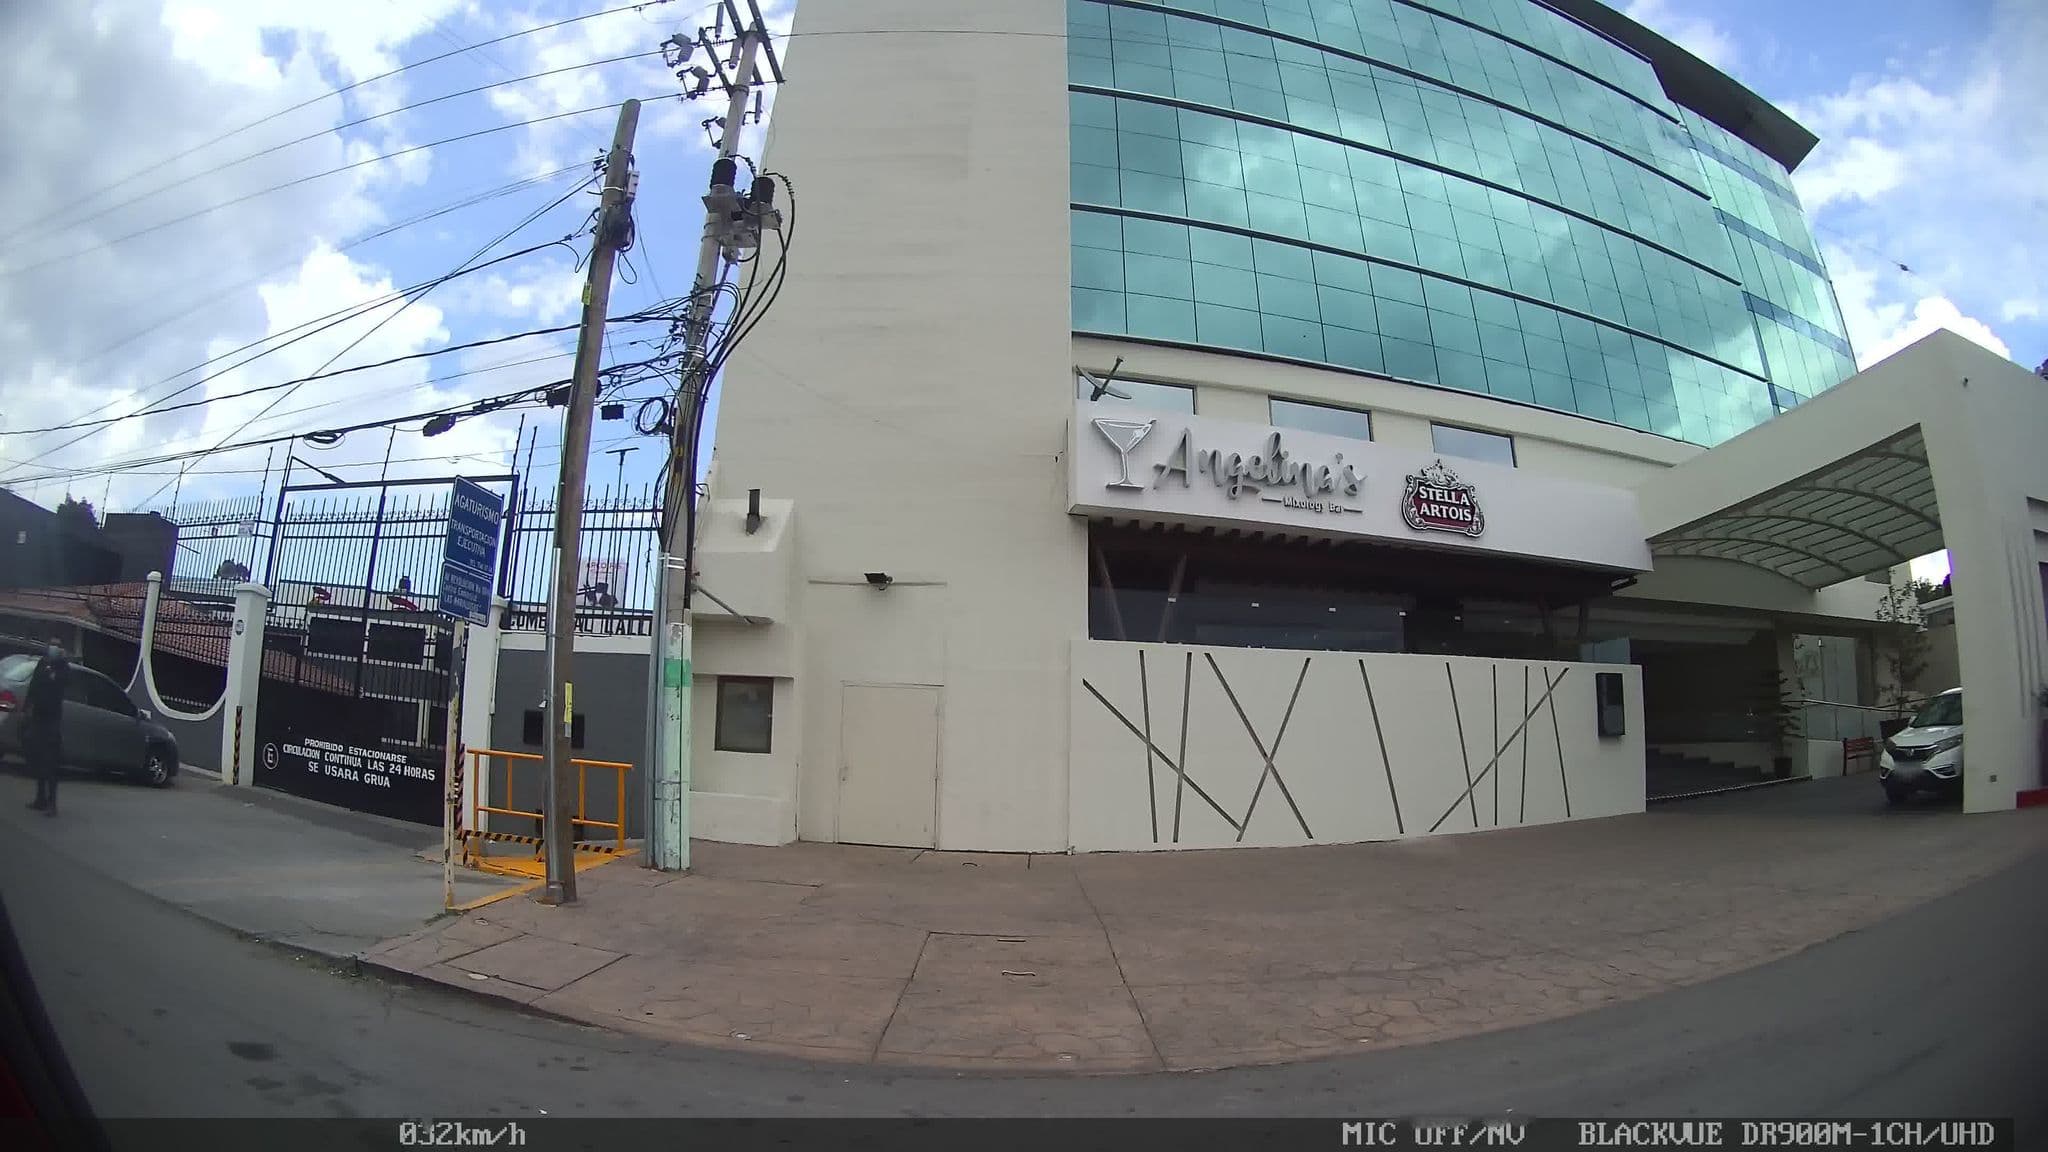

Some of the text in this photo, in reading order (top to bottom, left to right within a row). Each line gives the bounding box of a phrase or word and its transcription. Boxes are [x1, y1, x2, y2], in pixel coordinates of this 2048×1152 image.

[1153, 427, 1368, 499] Angelina's
[454, 494, 499, 525] AGATURISMO
[1419, 486, 1470, 506] STELLA
[1420, 503, 1472, 521] ARTOIS
[283, 744, 436, 781] CIRCULACION CONTINUA LAS 24 HORAS
[304, 738, 407, 764] PROHIBIDO ESTACIONARSE
[308, 761, 391, 788] SE USARA GRUA
